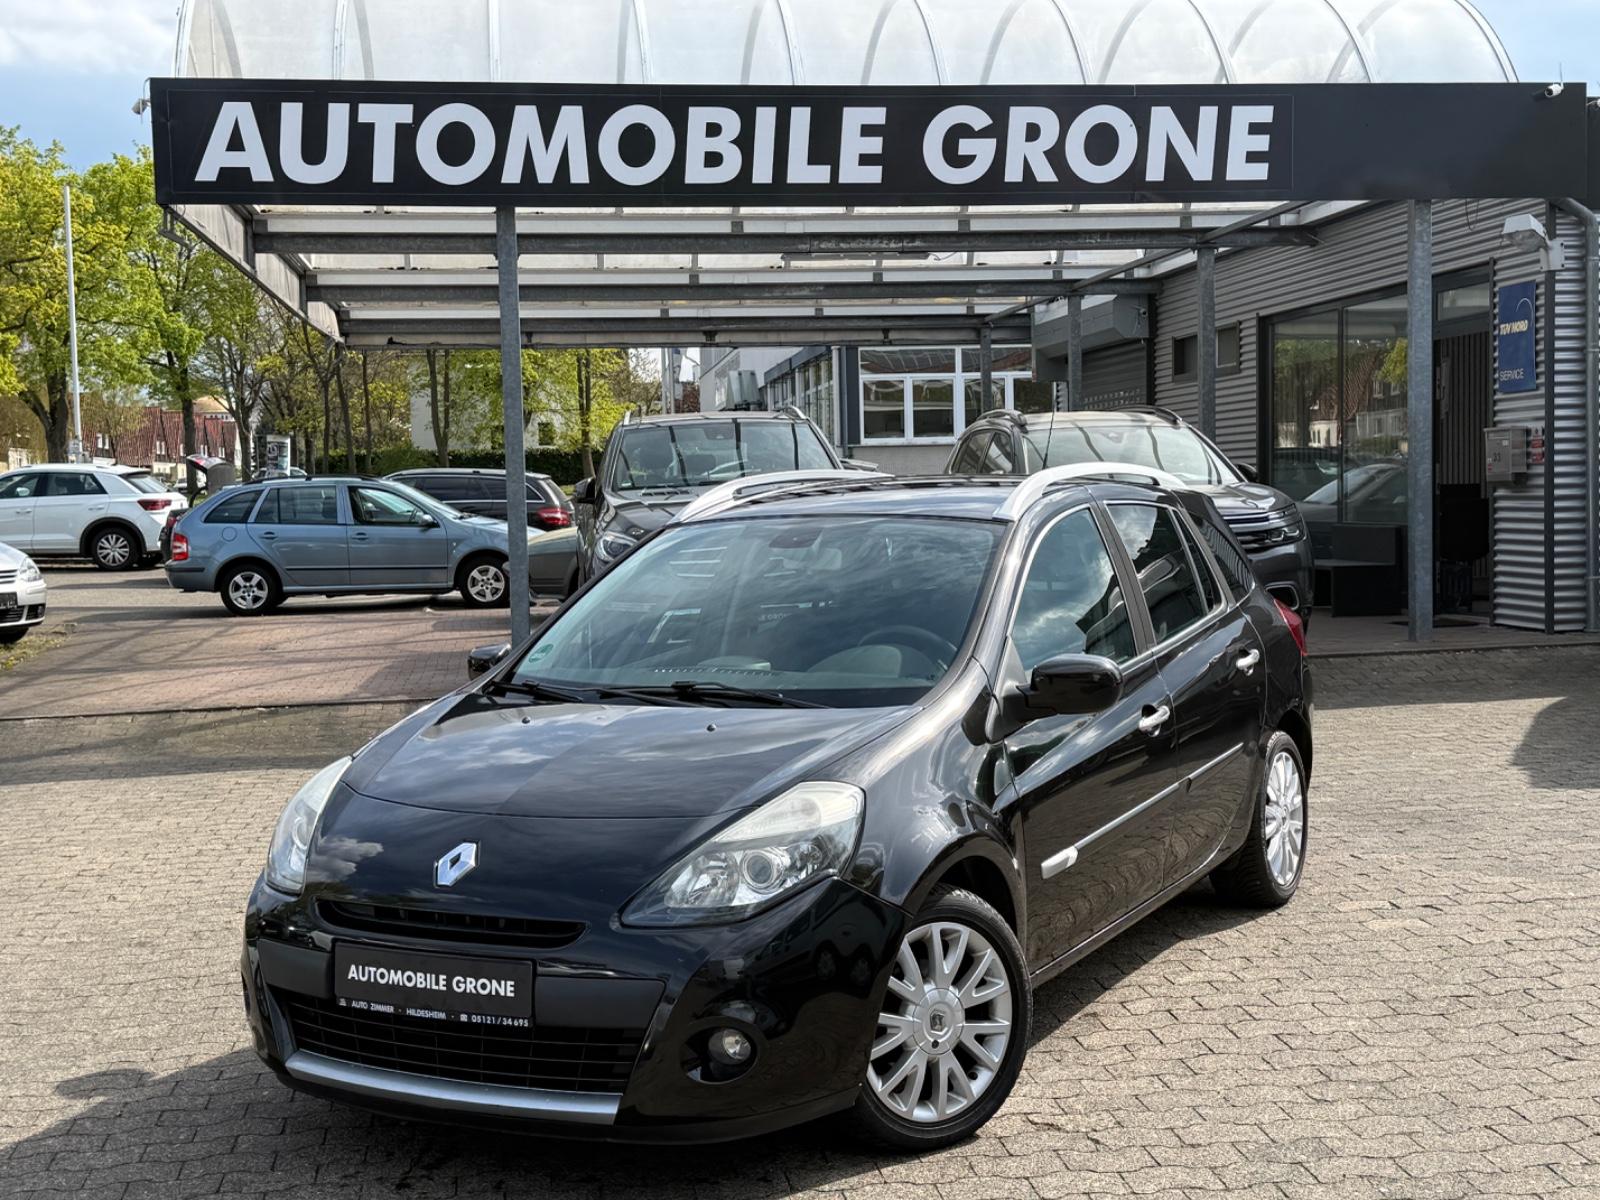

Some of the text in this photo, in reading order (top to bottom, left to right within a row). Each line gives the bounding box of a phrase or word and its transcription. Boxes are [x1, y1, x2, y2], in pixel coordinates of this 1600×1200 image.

[195, 102, 1275, 187] AUTOMOBILE GRONE
[1511, 320, 1528, 333] NORD
[1500, 368, 1524, 381] SERVICE
[348, 964, 515, 998] AUTOMOBILE GRONE
[351, 1000, 368, 1010] AUTO
[370, 1003, 395, 1014] ZIMMER
[406, 1008, 447, 1020] HILDESHEIM
